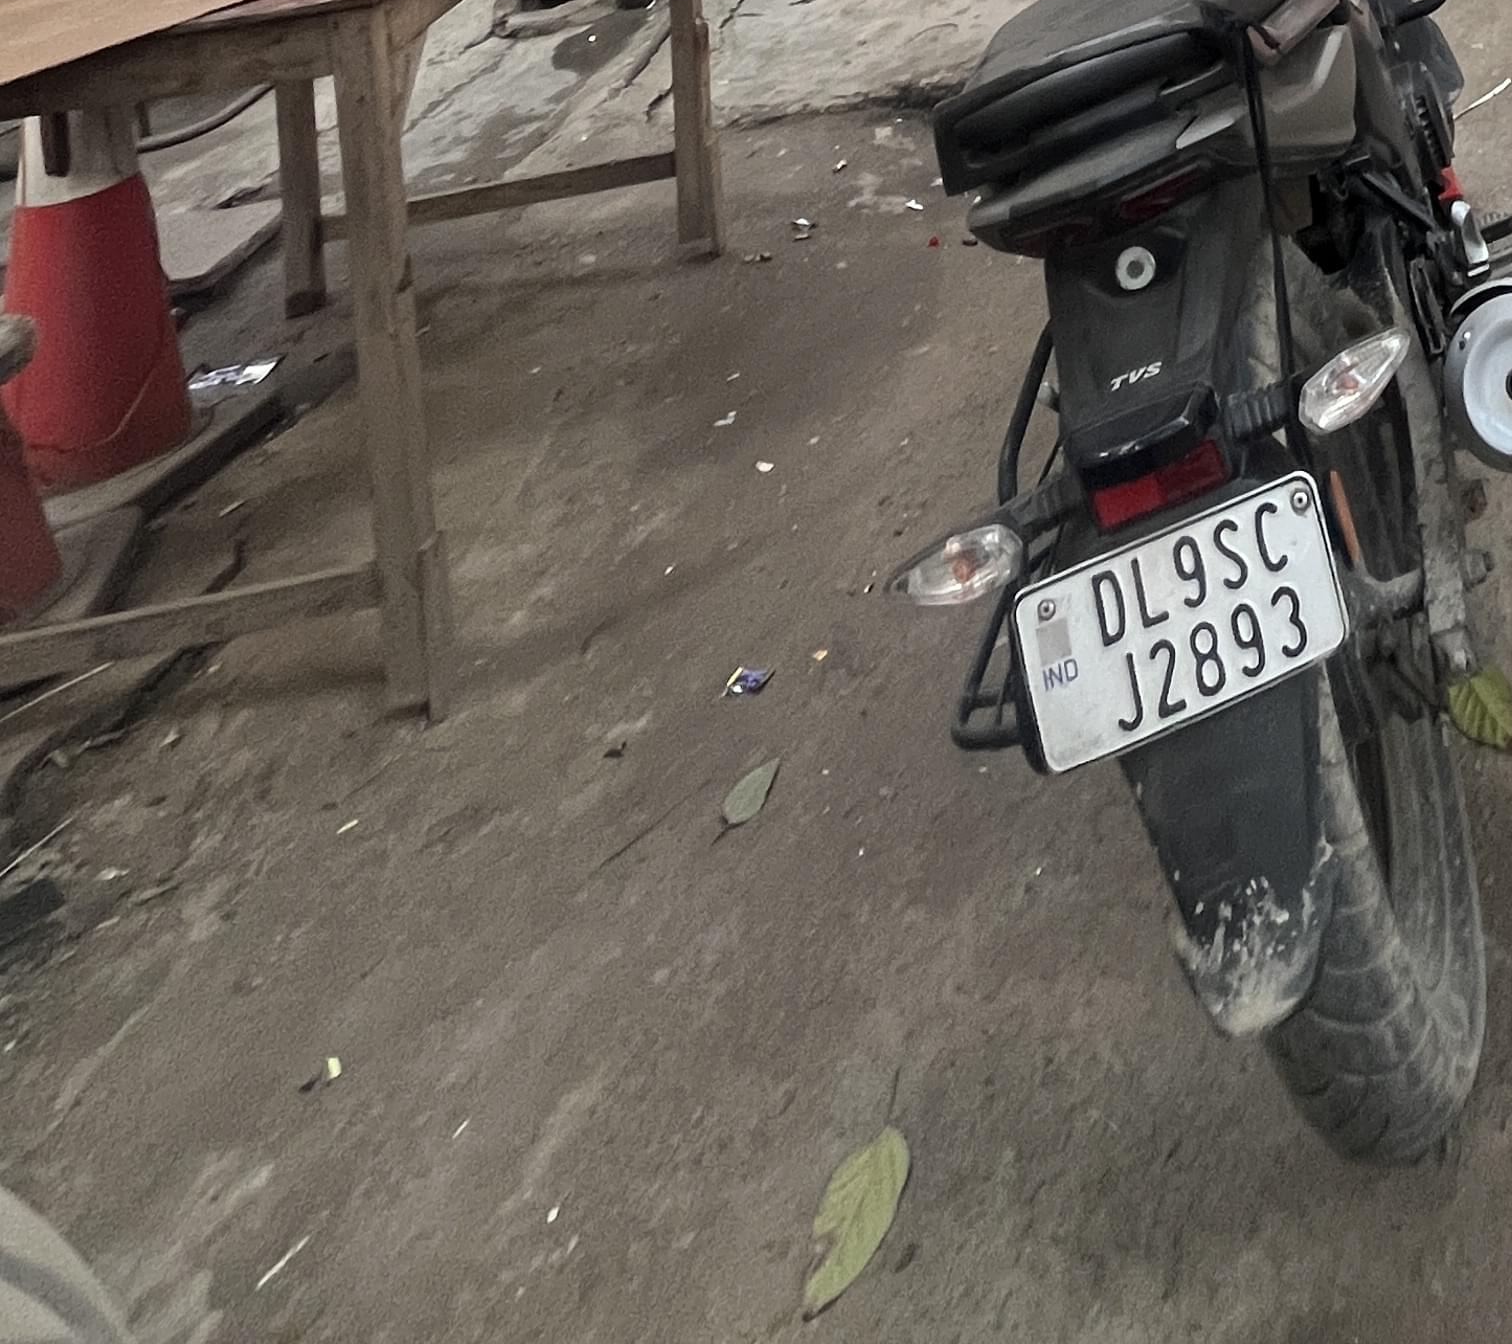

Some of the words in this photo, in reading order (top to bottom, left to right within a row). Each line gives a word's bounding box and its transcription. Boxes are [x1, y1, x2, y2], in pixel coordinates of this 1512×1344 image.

[1109, 359, 1163, 392] TVS
[1091, 501, 1290, 648] DL9SC
[1042, 658, 1080, 693] IND
[1118, 586, 1309, 732] J2893
